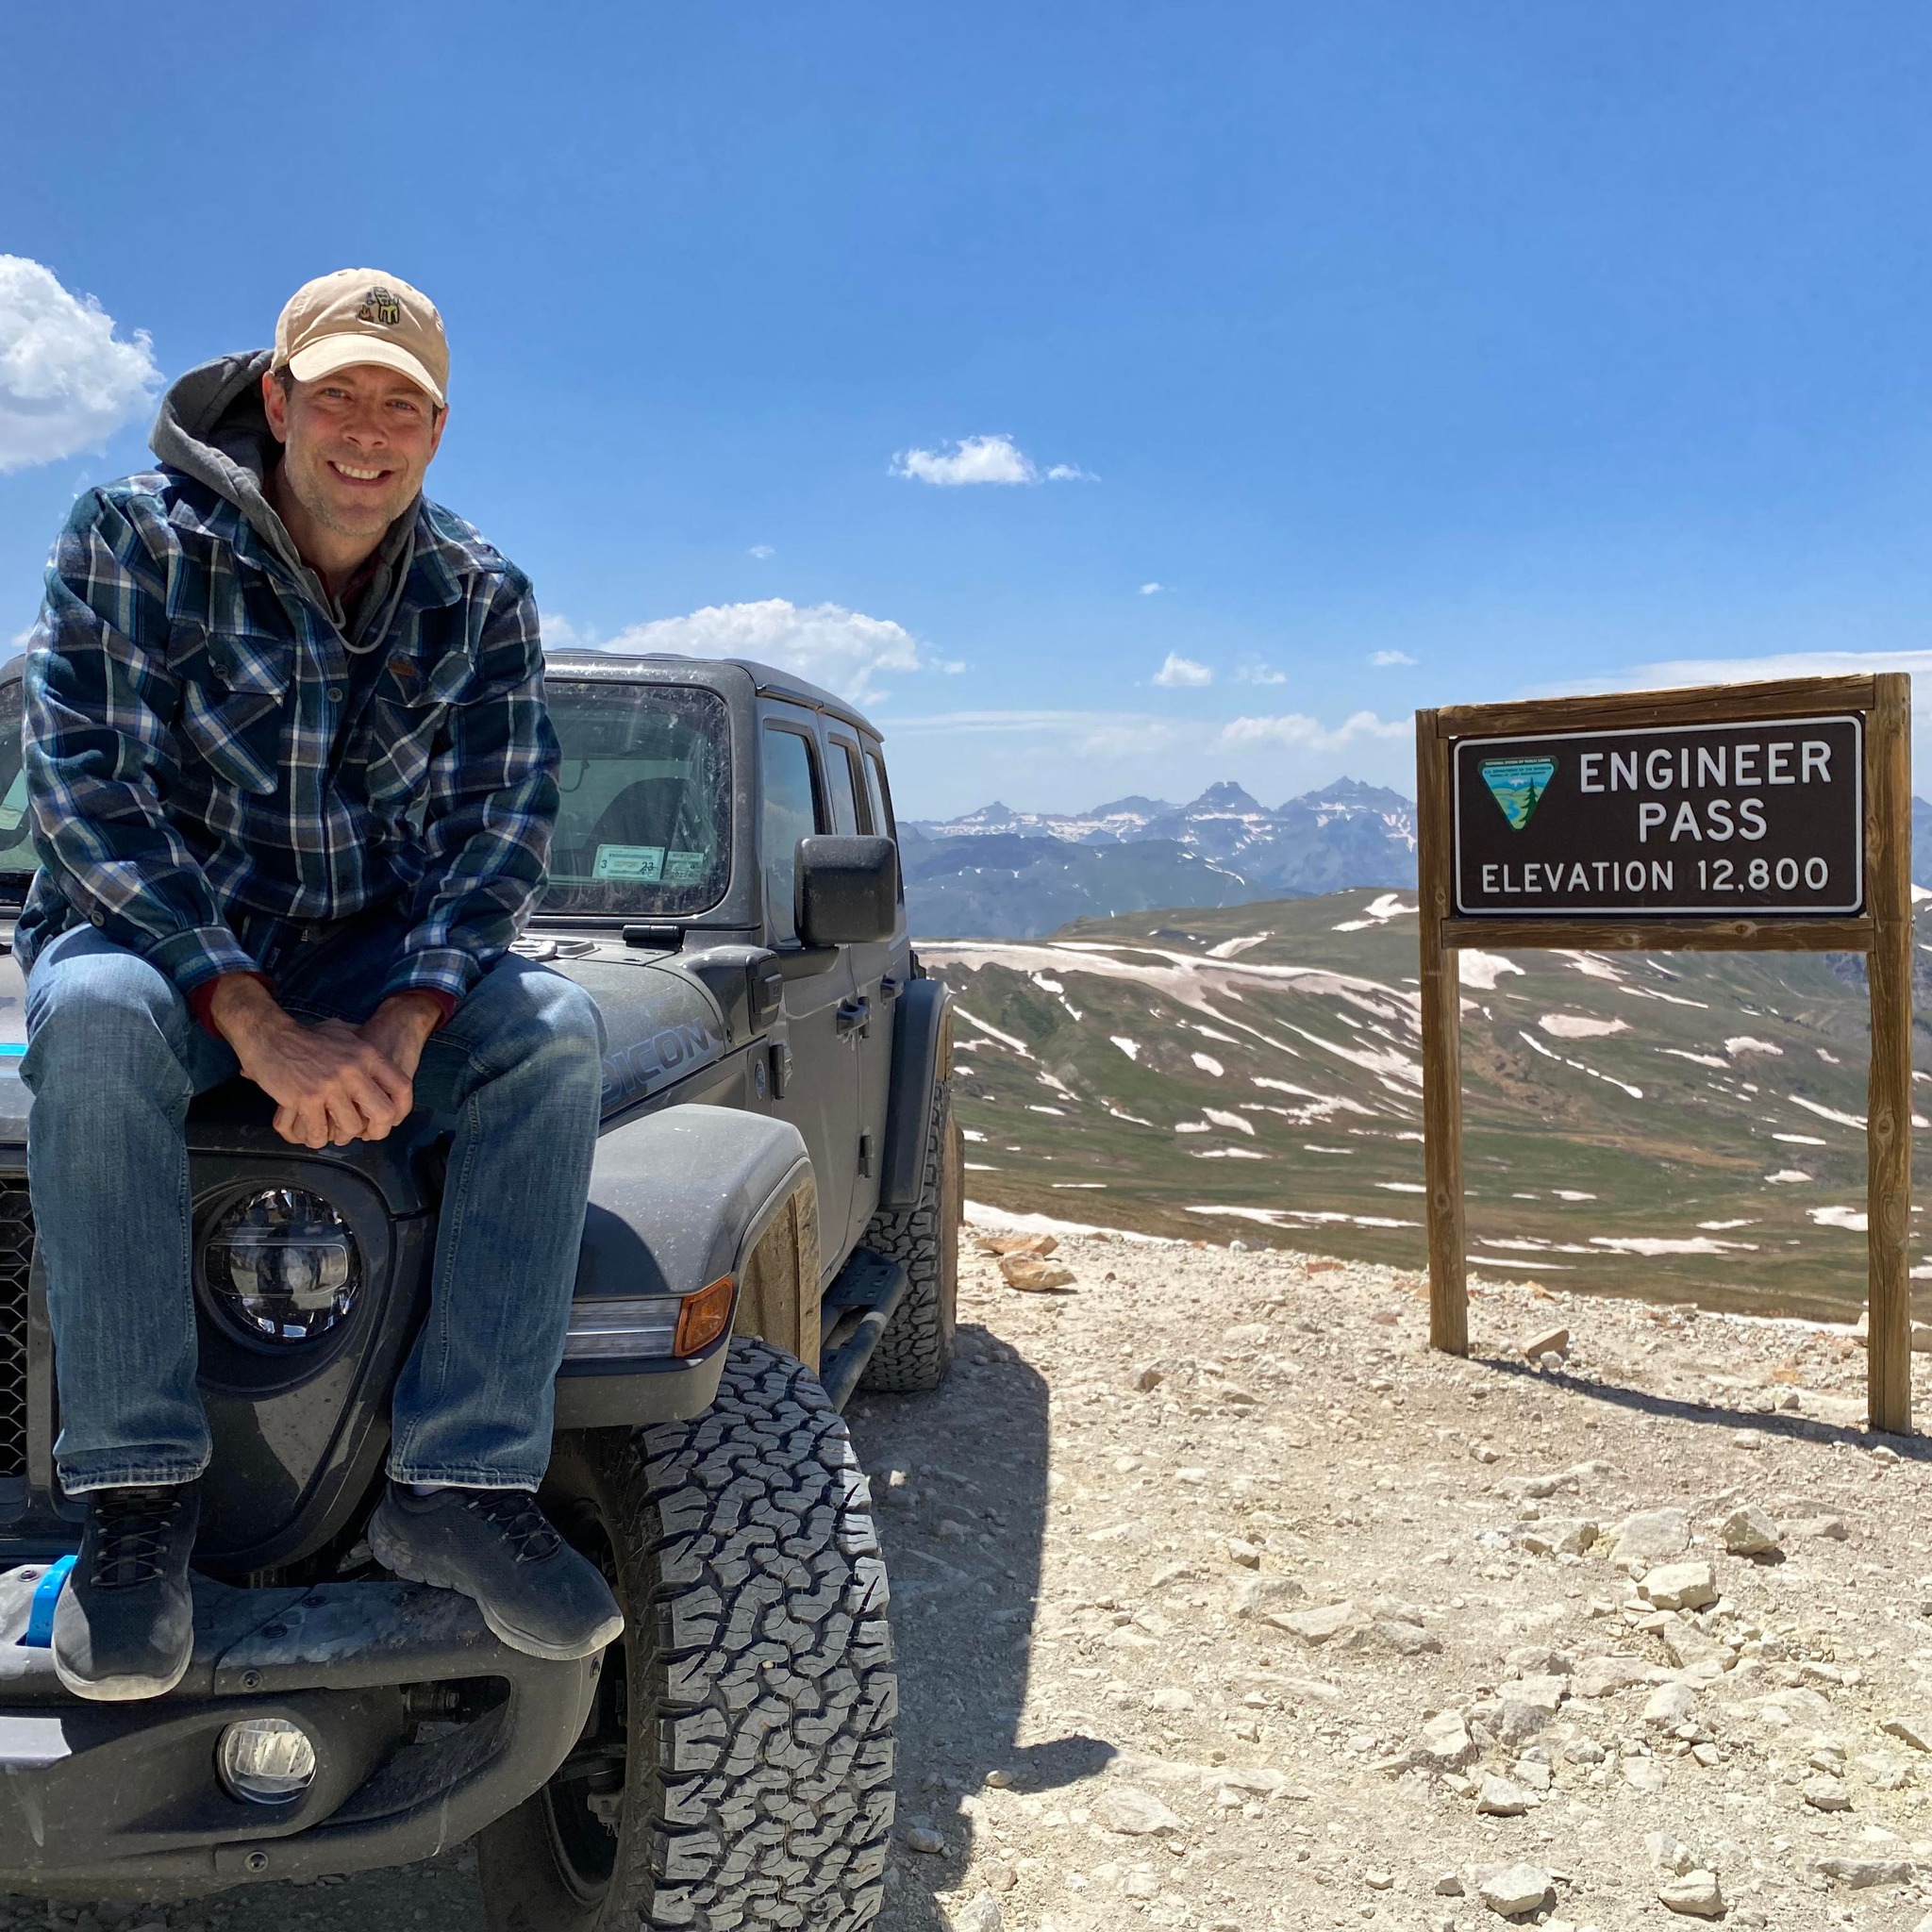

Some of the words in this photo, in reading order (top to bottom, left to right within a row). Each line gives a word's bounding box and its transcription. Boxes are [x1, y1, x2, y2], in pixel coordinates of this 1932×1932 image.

[1580, 741, 1832, 793] ENGINEER
[1639, 797, 1767, 843] PASS
[1482, 860, 1674, 893] ELEVATION
[1697, 857, 1829, 894] 12,800
[602, 1017, 710, 1106] BICON
